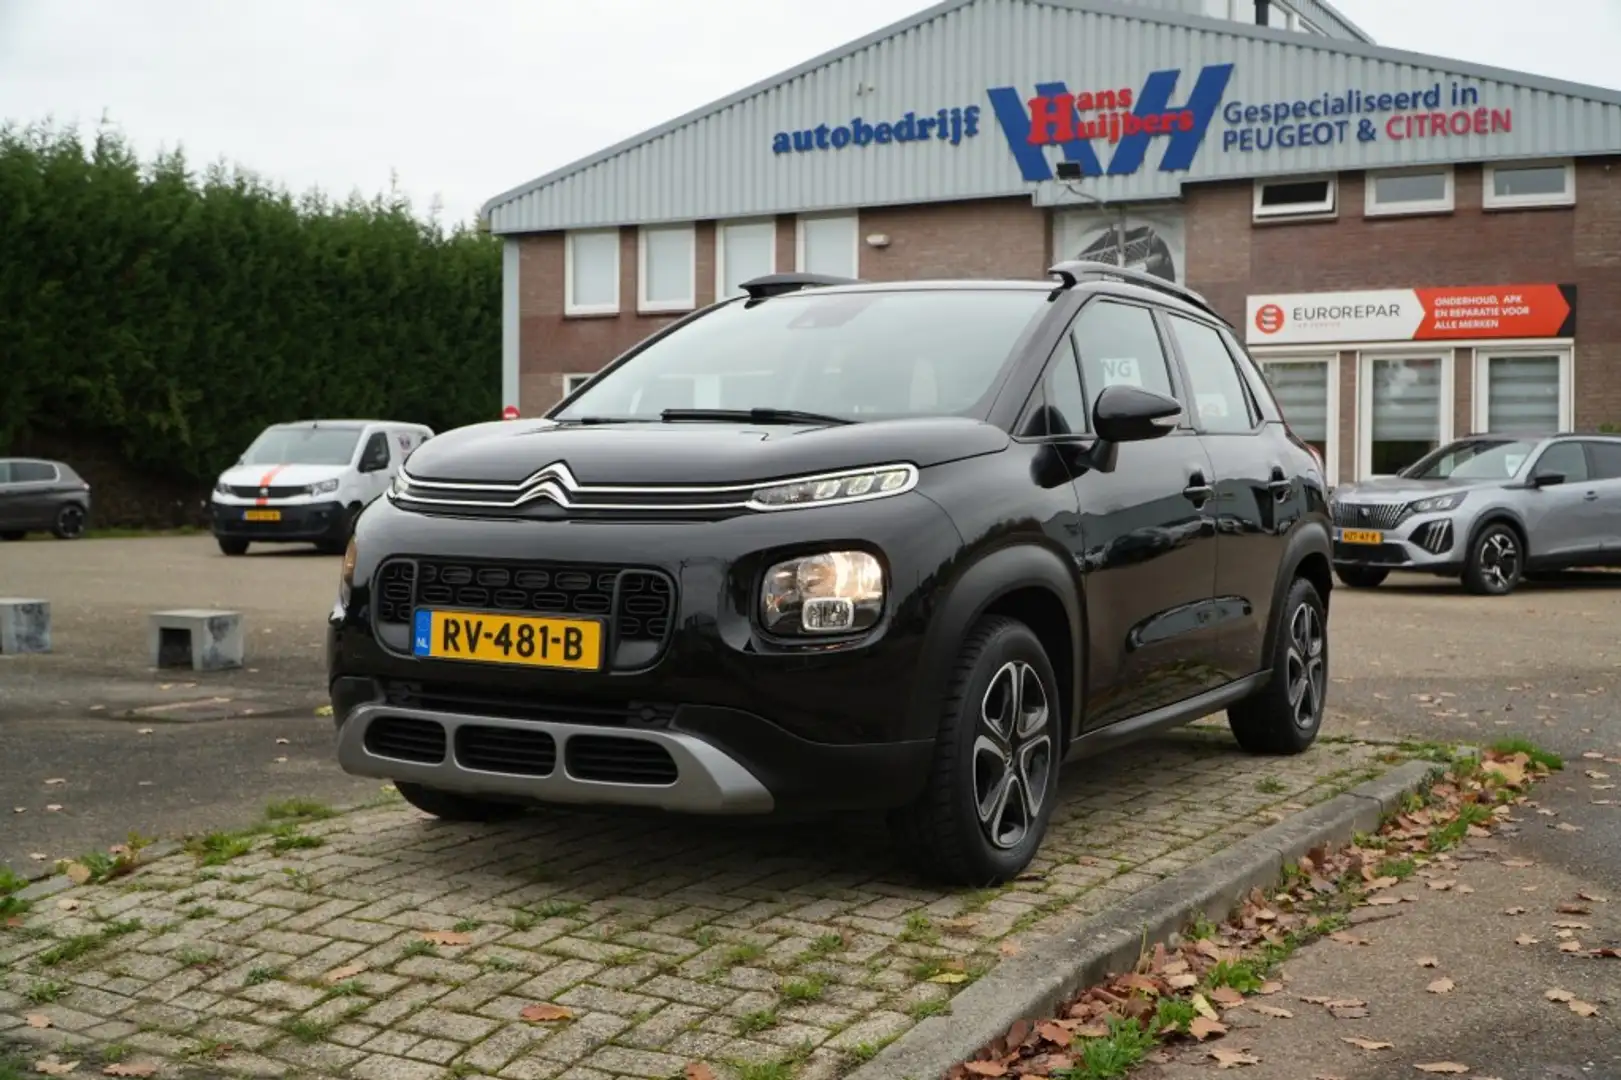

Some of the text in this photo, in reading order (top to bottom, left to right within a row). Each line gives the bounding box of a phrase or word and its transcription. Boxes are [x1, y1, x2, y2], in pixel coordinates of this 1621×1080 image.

[1027, 88, 1133, 146] Hans
[1223, 82, 1478, 125] Gespecialiseerd in
[772, 105, 981, 154] autobedrijf
[1223, 107, 1513, 152] PEUGEOT & CITROËN
[1292, 304, 1400, 321] EUROREPAR
[1434, 305, 1530, 318] EN REPARATIE VOOR
[1503, 295, 1522, 304] APK
[1434, 319, 1499, 330] ALLE MERKEN
[416, 637, 429, 649] NL
[443, 618, 583, 661] RV-481-B
